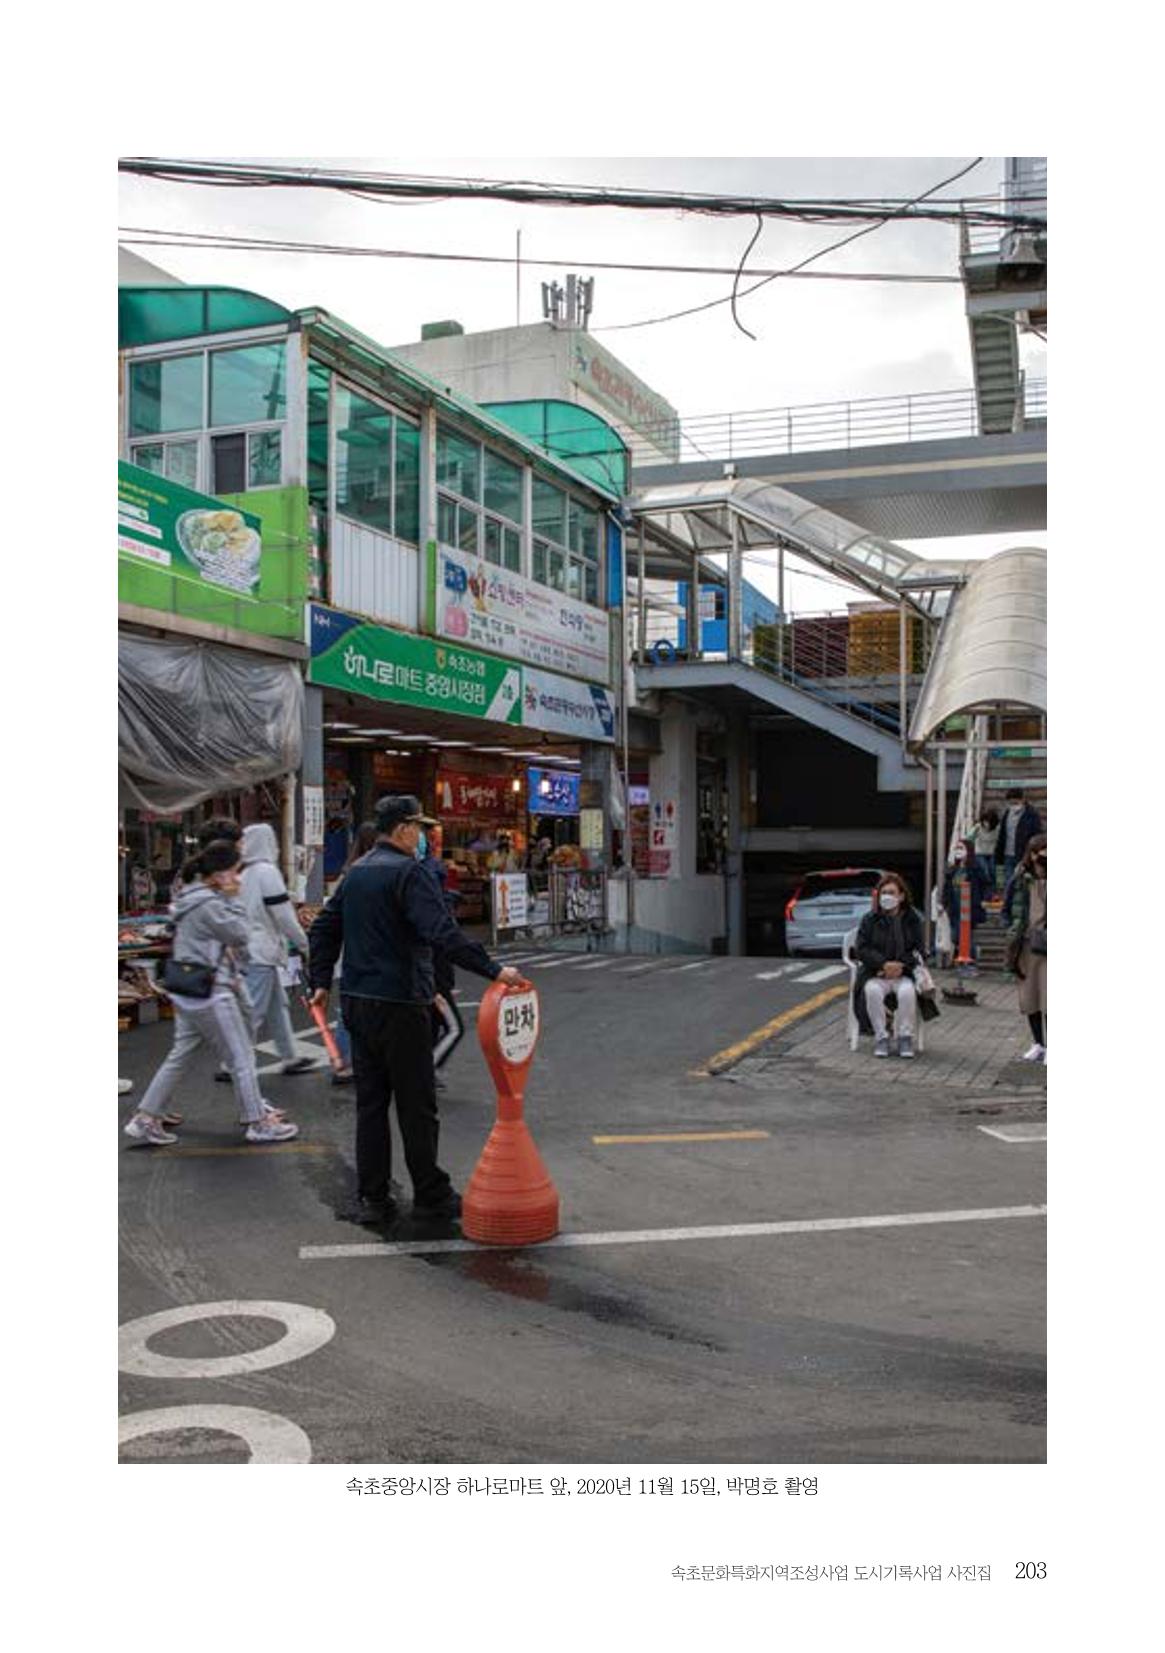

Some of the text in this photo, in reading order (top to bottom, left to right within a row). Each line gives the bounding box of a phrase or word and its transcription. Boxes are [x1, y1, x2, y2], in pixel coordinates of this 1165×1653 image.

[343, 644, 423, 693] 하나로마트
[424, 672, 486, 706] 중앙시장점
[504, 1002, 535, 1037] 만차
